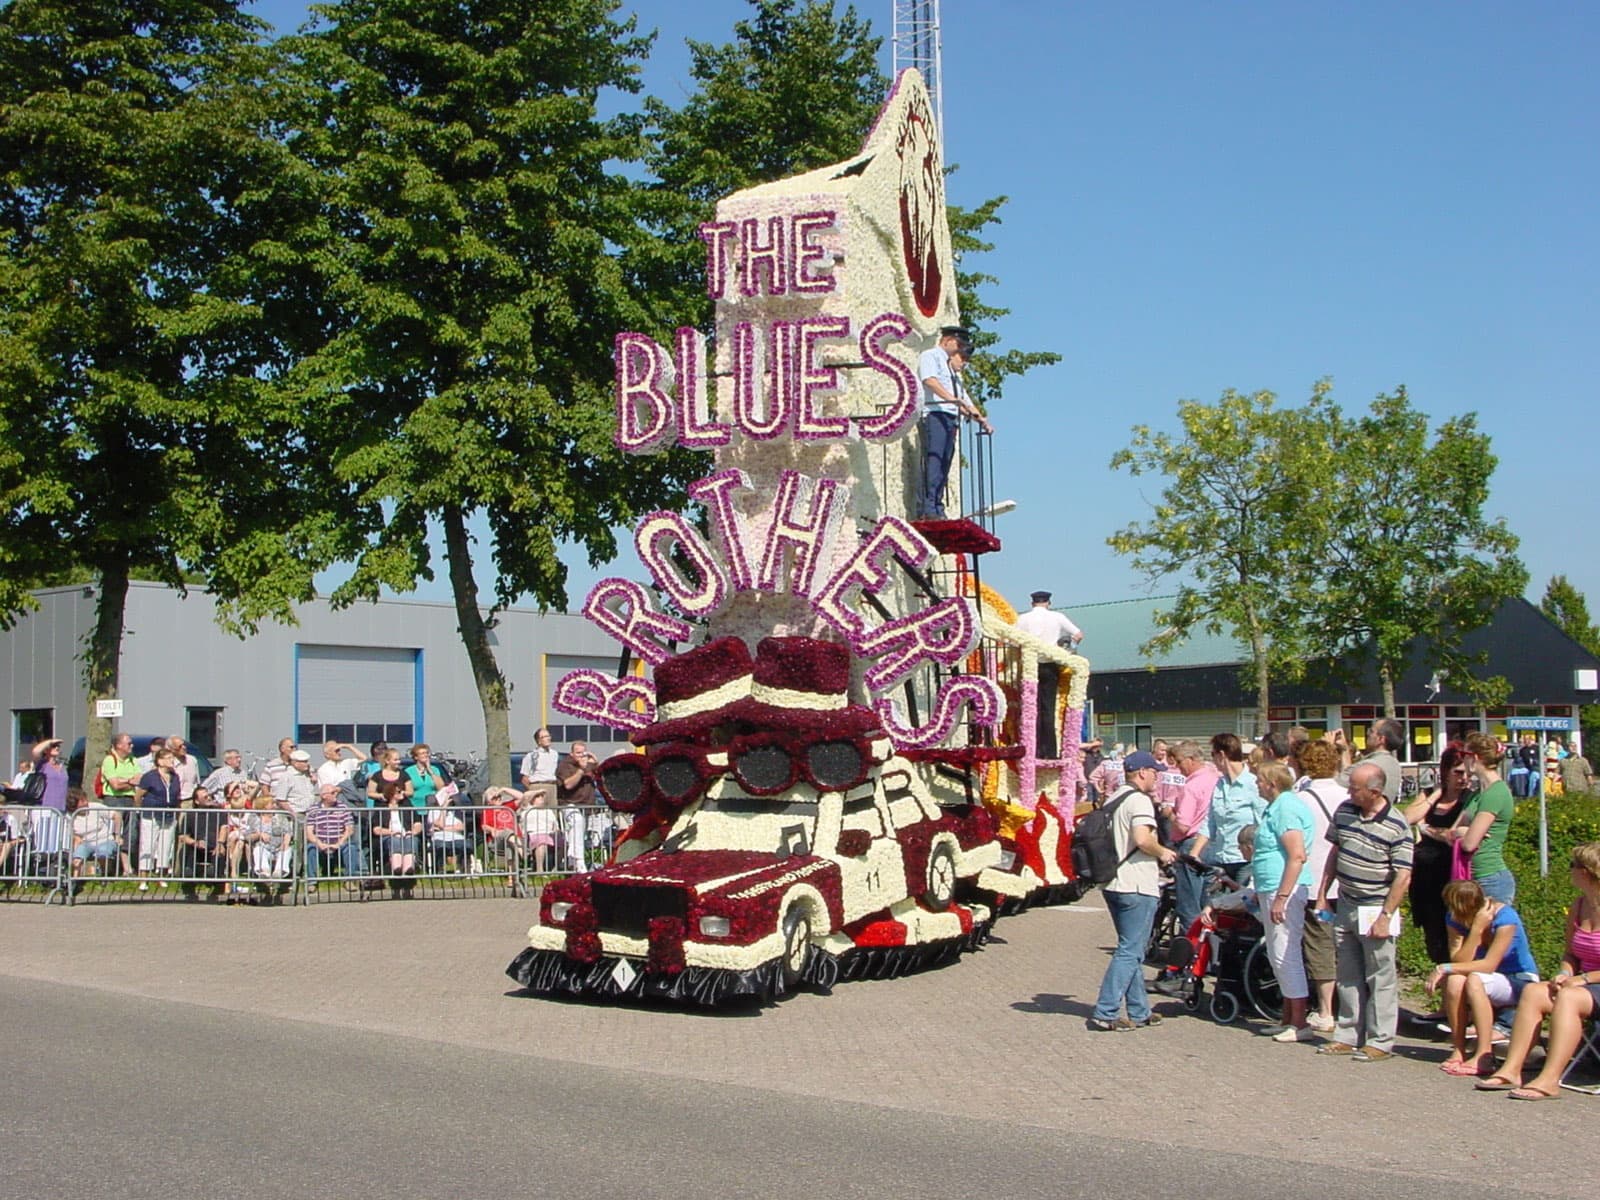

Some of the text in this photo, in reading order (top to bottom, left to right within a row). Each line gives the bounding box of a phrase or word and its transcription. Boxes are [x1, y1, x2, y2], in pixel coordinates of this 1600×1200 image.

[700, 210, 838, 300] THE
[614, 312, 919, 452] BLUES
[552, 467, 1001, 751] BROTHERS
[1510, 719, 1569, 729] PRODUCTIEWEG
